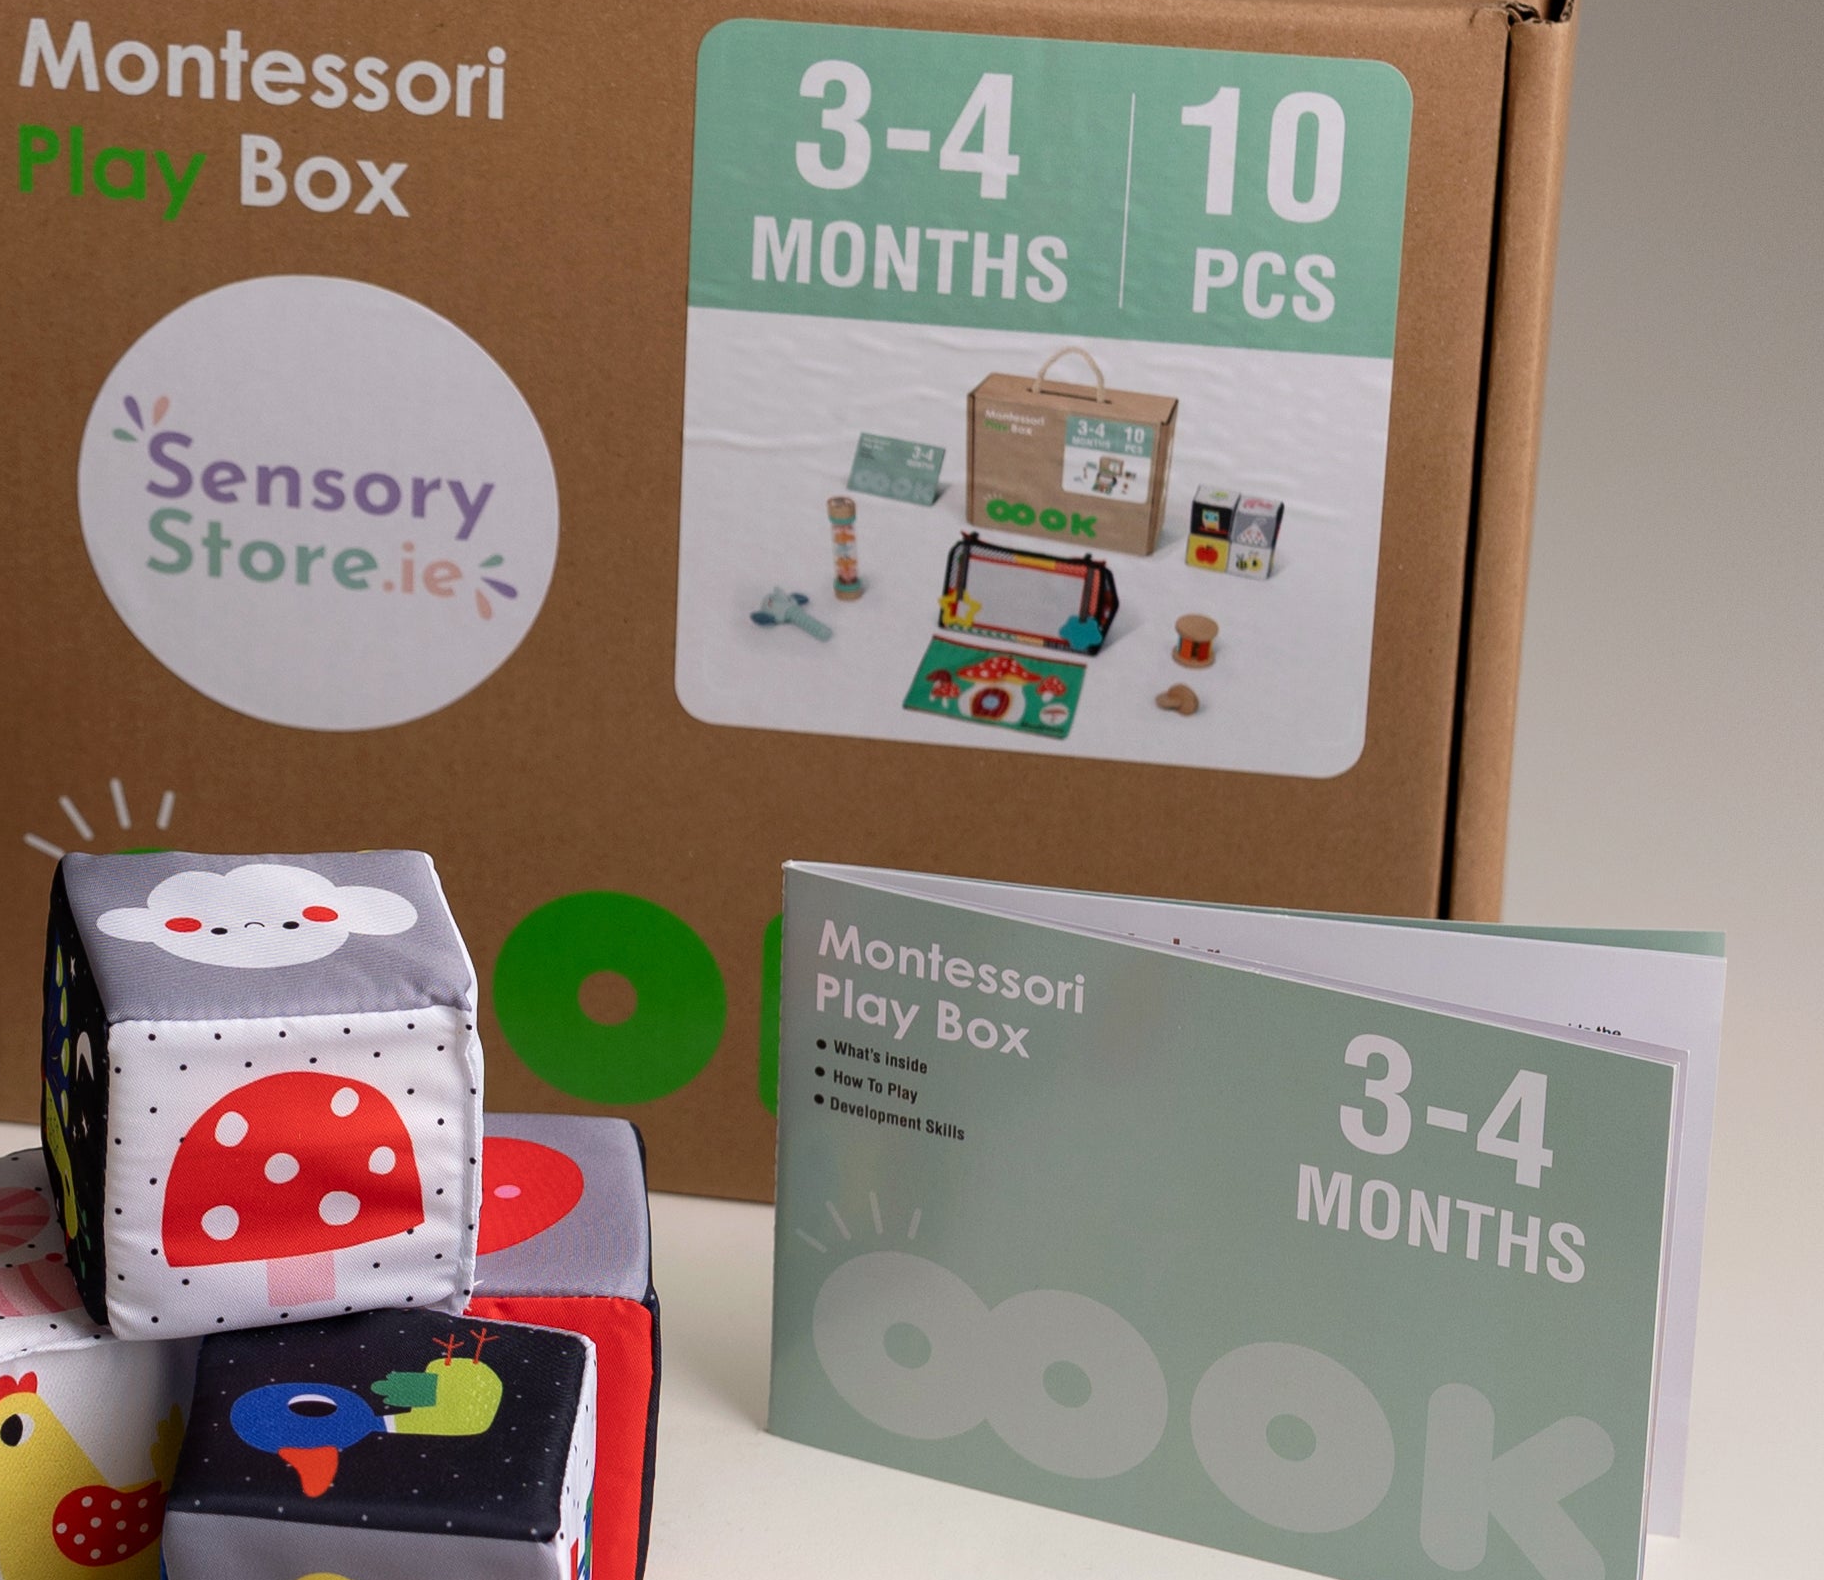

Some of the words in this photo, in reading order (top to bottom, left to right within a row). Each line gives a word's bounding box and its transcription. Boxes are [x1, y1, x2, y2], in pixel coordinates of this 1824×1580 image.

[18, 18, 505, 121] Montessori
[18, 125, 207, 219] Play
[239, 134, 410, 217] Box
[794, 60, 1021, 200] 3-4
[1180, 86, 1346, 224] 10
[751, 216, 1069, 304] MONTHS
[1191, 248, 1337, 322] PCS
[1125, 426, 1145, 443] 10
[145, 431, 494, 540] Sensory
[145, 507, 464, 599] Store.ie
[818, 919, 1085, 1013] Montessori
[816, 973, 920, 1040] Play
[937, 999, 1030, 1058] Box
[830, 1097, 921, 1131] Development
[925, 1119, 965, 1141] Skills
[833, 1069, 863, 1089] How
[868, 1077, 883, 1094] To
[888, 1082, 918, 1104] Play
[1339, 1033, 1555, 1190] 3-4
[1295, 1163, 1588, 1284] MONTHS
